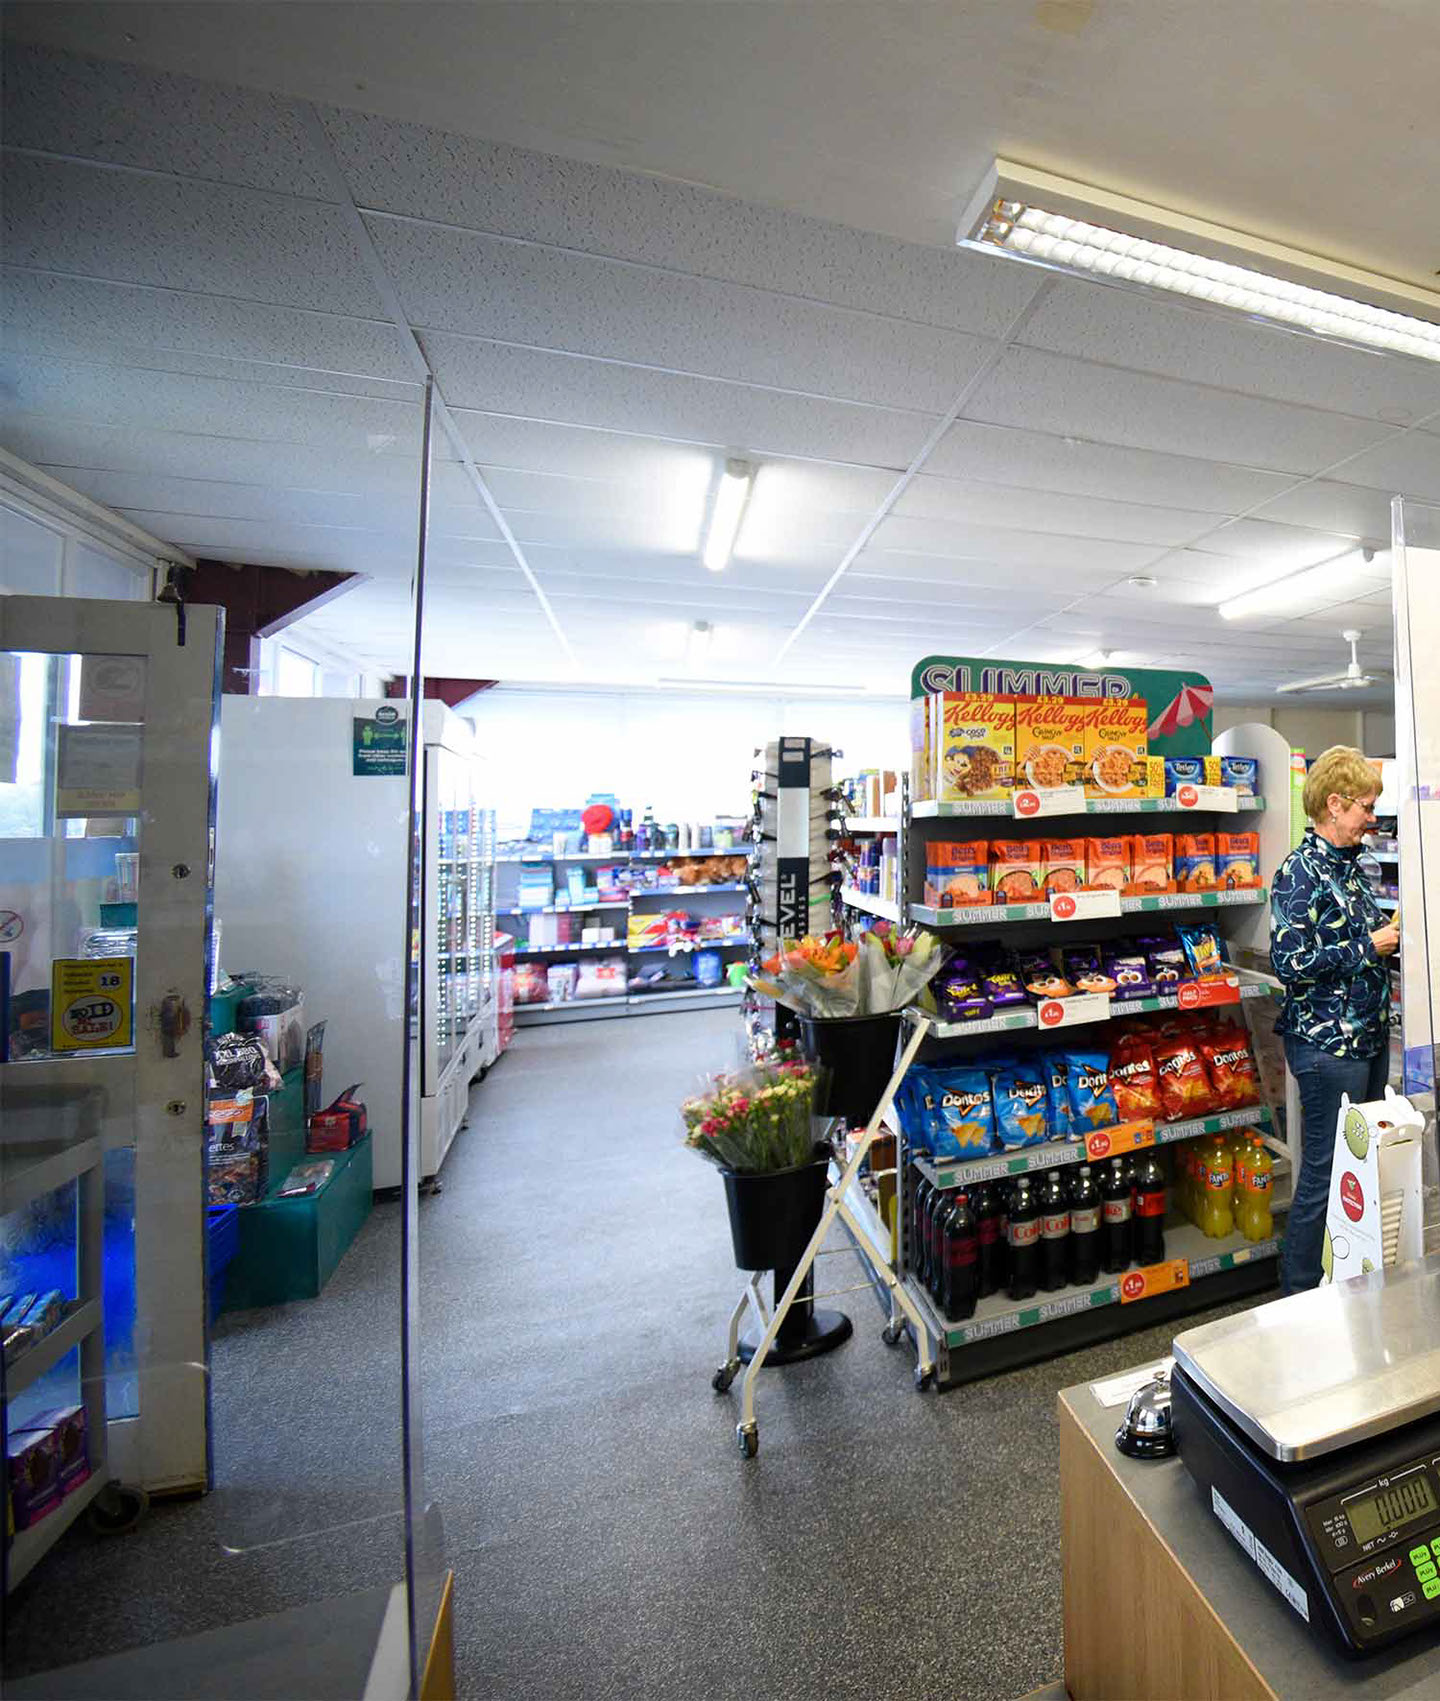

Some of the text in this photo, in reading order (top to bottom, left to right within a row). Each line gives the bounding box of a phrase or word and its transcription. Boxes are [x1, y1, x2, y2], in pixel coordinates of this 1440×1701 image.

[1158, 894, 1202, 907] SUMMER
[101, 976, 120, 986] 18
[1159, 1050, 1197, 1076] Doritos
[1213, 1048, 1249, 1068] Doritos
[942, 1091, 991, 1107] Doritos
[1160, 1122, 1206, 1141] SUMMER
[1028, 1149, 1079, 1169] SUMMER
[954, 1162, 1009, 1183] SUMMER
[1039, 1295, 1092, 1318] SUMMER
[963, 1315, 1020, 1337] SUMMER
[1378, 1478, 1389, 1488] kg
[1362, 1541, 1375, 1552] NET
[1357, 1559, 1396, 1584] Avery Berkel
